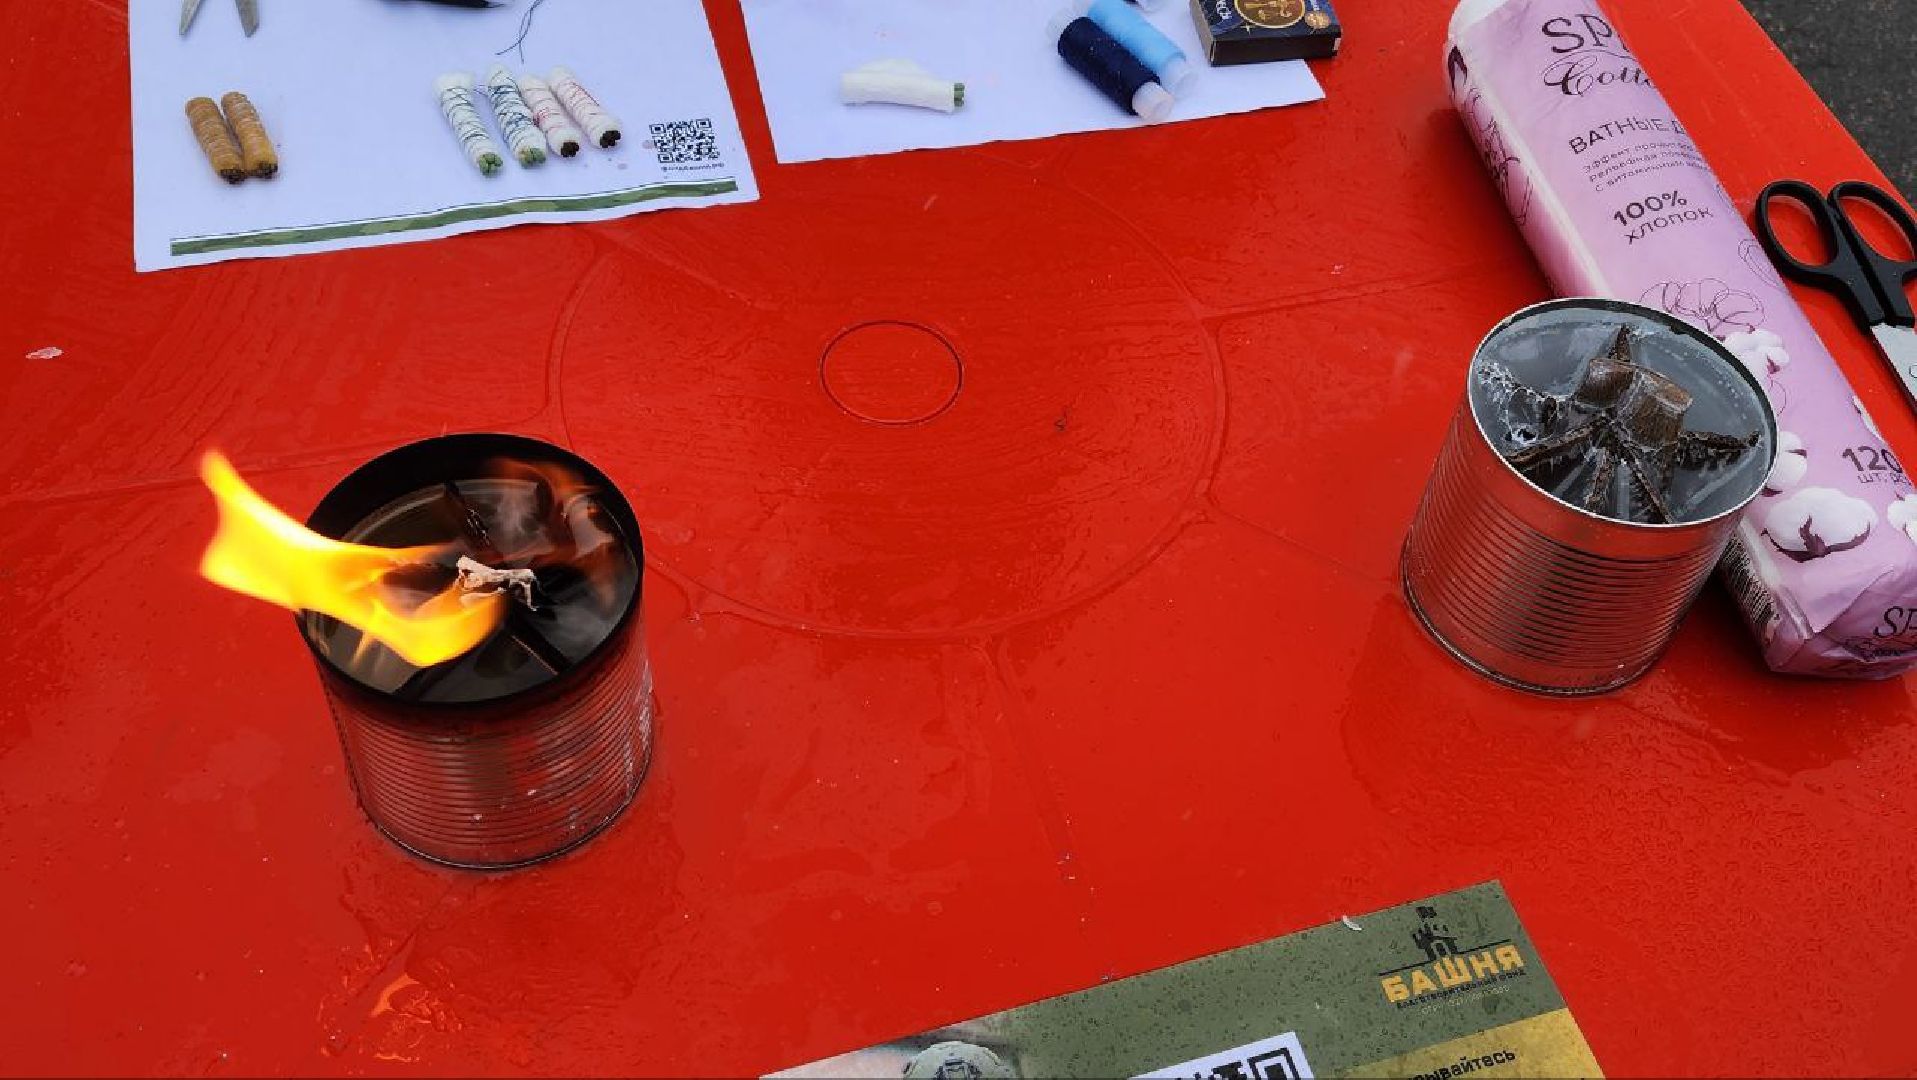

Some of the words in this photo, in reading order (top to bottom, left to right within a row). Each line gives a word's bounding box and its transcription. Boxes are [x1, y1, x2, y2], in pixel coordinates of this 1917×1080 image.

[1541, 14, 1629, 53] SP
[1570, 116, 1669, 154] ВАТНЫЕ
[1614, 190, 1688, 226] 100%
[1842, 445, 1903, 473] 120
[1873, 605, 1917, 638] SP
[1381, 944, 1525, 1003] БАШНЯ
